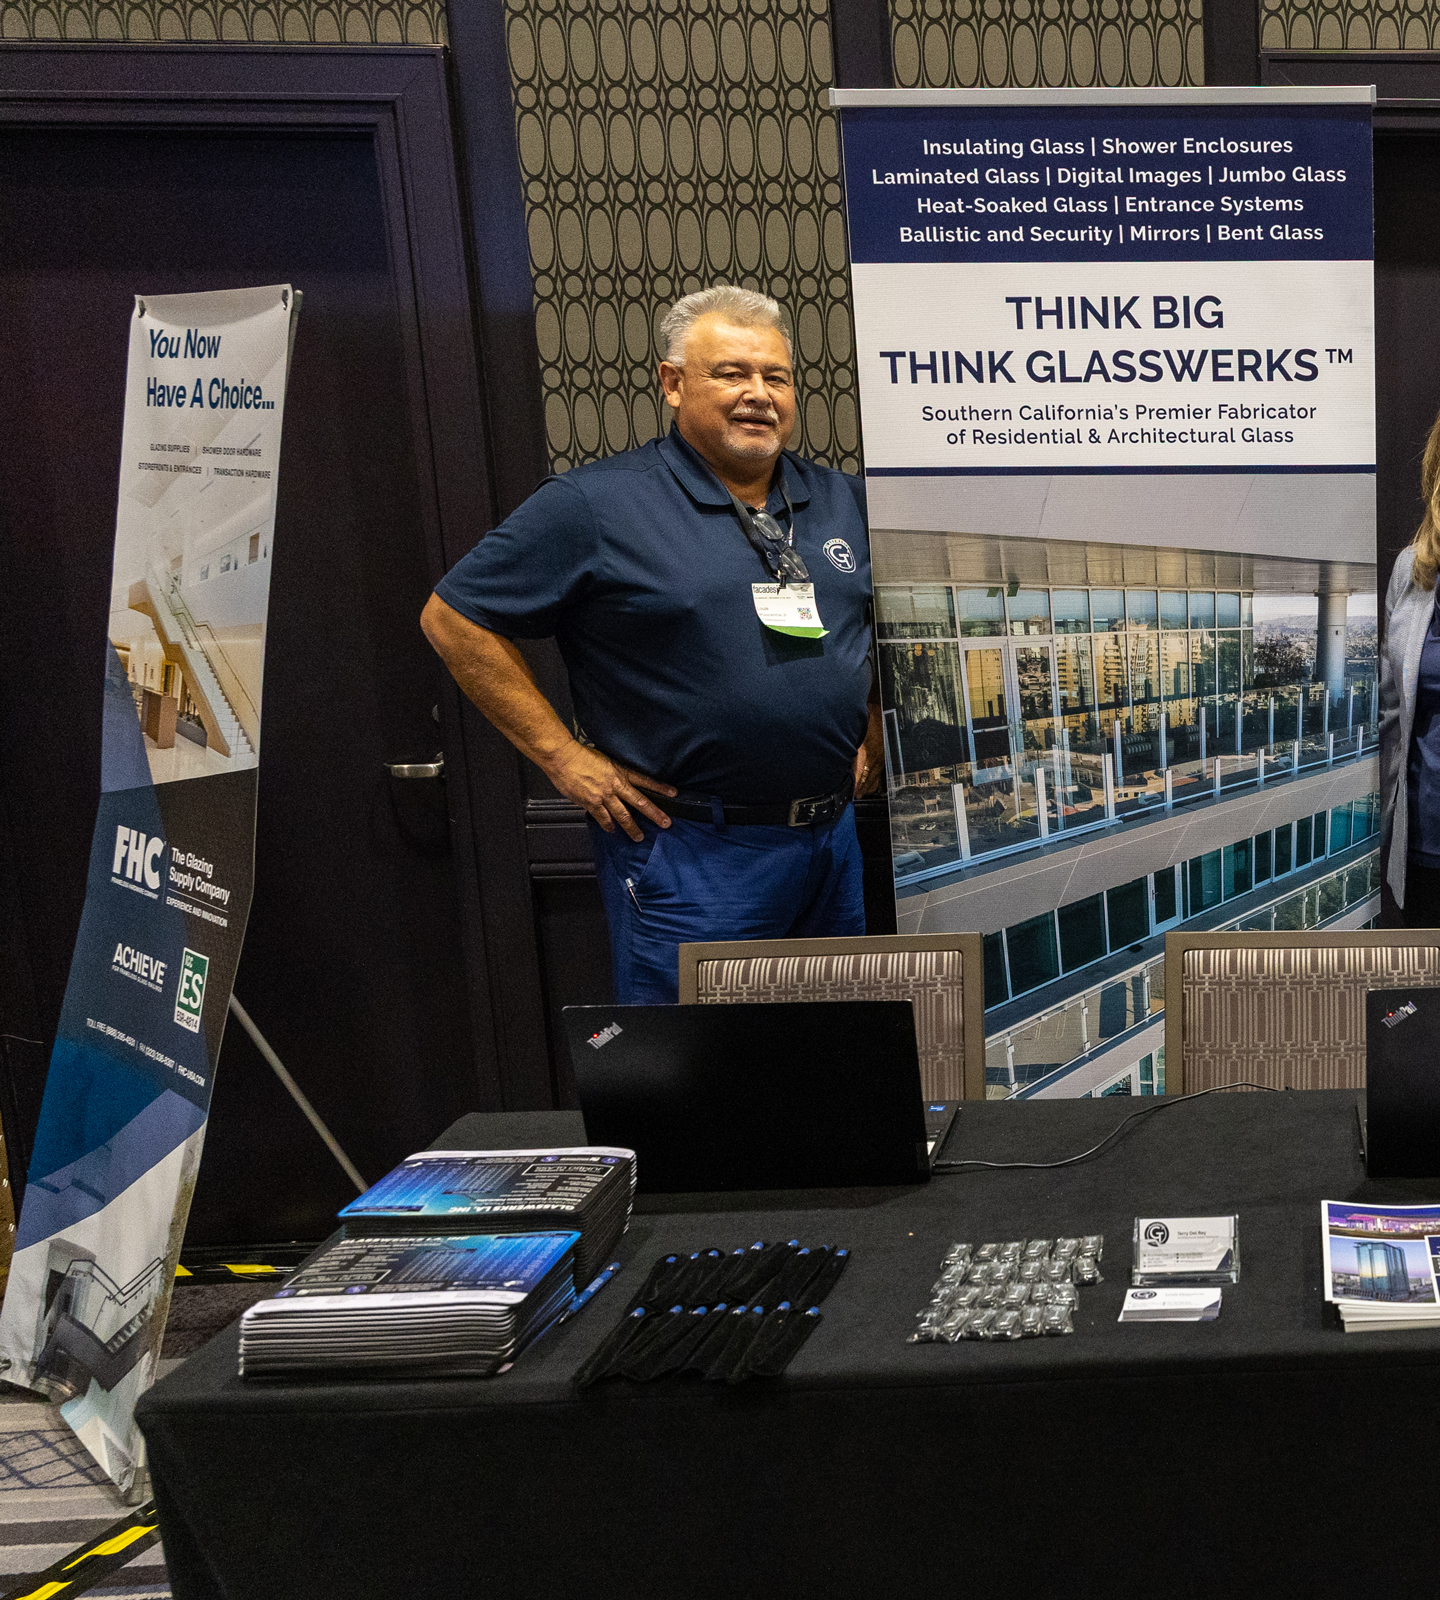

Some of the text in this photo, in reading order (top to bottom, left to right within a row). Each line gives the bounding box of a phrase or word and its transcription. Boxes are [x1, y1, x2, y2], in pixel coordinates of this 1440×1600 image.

[923, 136, 1293, 158] Insulating Glass Shower Enclosures
[872, 165, 1346, 187] Laminated Glass Digital Images Jumbo Glass
[917, 194, 1303, 216] Heat-Soaked Glass Entrance Systems
[900, 223, 1323, 246] Ballistic and Security Mirrors Bent Glass
[1006, 295, 1224, 331] THINK BIG
[150, 329, 221, 358] You Now
[880, 350, 1016, 384] THINK
[1026, 348, 1319, 383] GLASSWERKS
[147, 377, 274, 410] Have A Choice...
[922, 402, 1317, 423] Southern California's Premier Fabricator
[168, 444, 190, 453] SUPPLIES
[946, 426, 1293, 446] of Residential & Architectural Glass
[202, 447, 222, 455] SHOWER
[237, 448, 261, 456] HARDWARE
[174, 465, 202, 474] ENTRANCES
[214, 468, 271, 479] TRANSACTION HARDWARE
[112, 825, 164, 890] FHC
[172, 847, 213, 879] The Glazing
[169, 866, 195, 892] Supply
[195, 876, 231, 905] Company
[113, 943, 166, 985] ACHIEVE
[180, 968, 203, 1009] ES
[1381, 1001, 1417, 1028] ThinkPad
[587, 1022, 623, 1049] ThinkPad
[492, 1204, 575, 1212] GLASSWERKS
